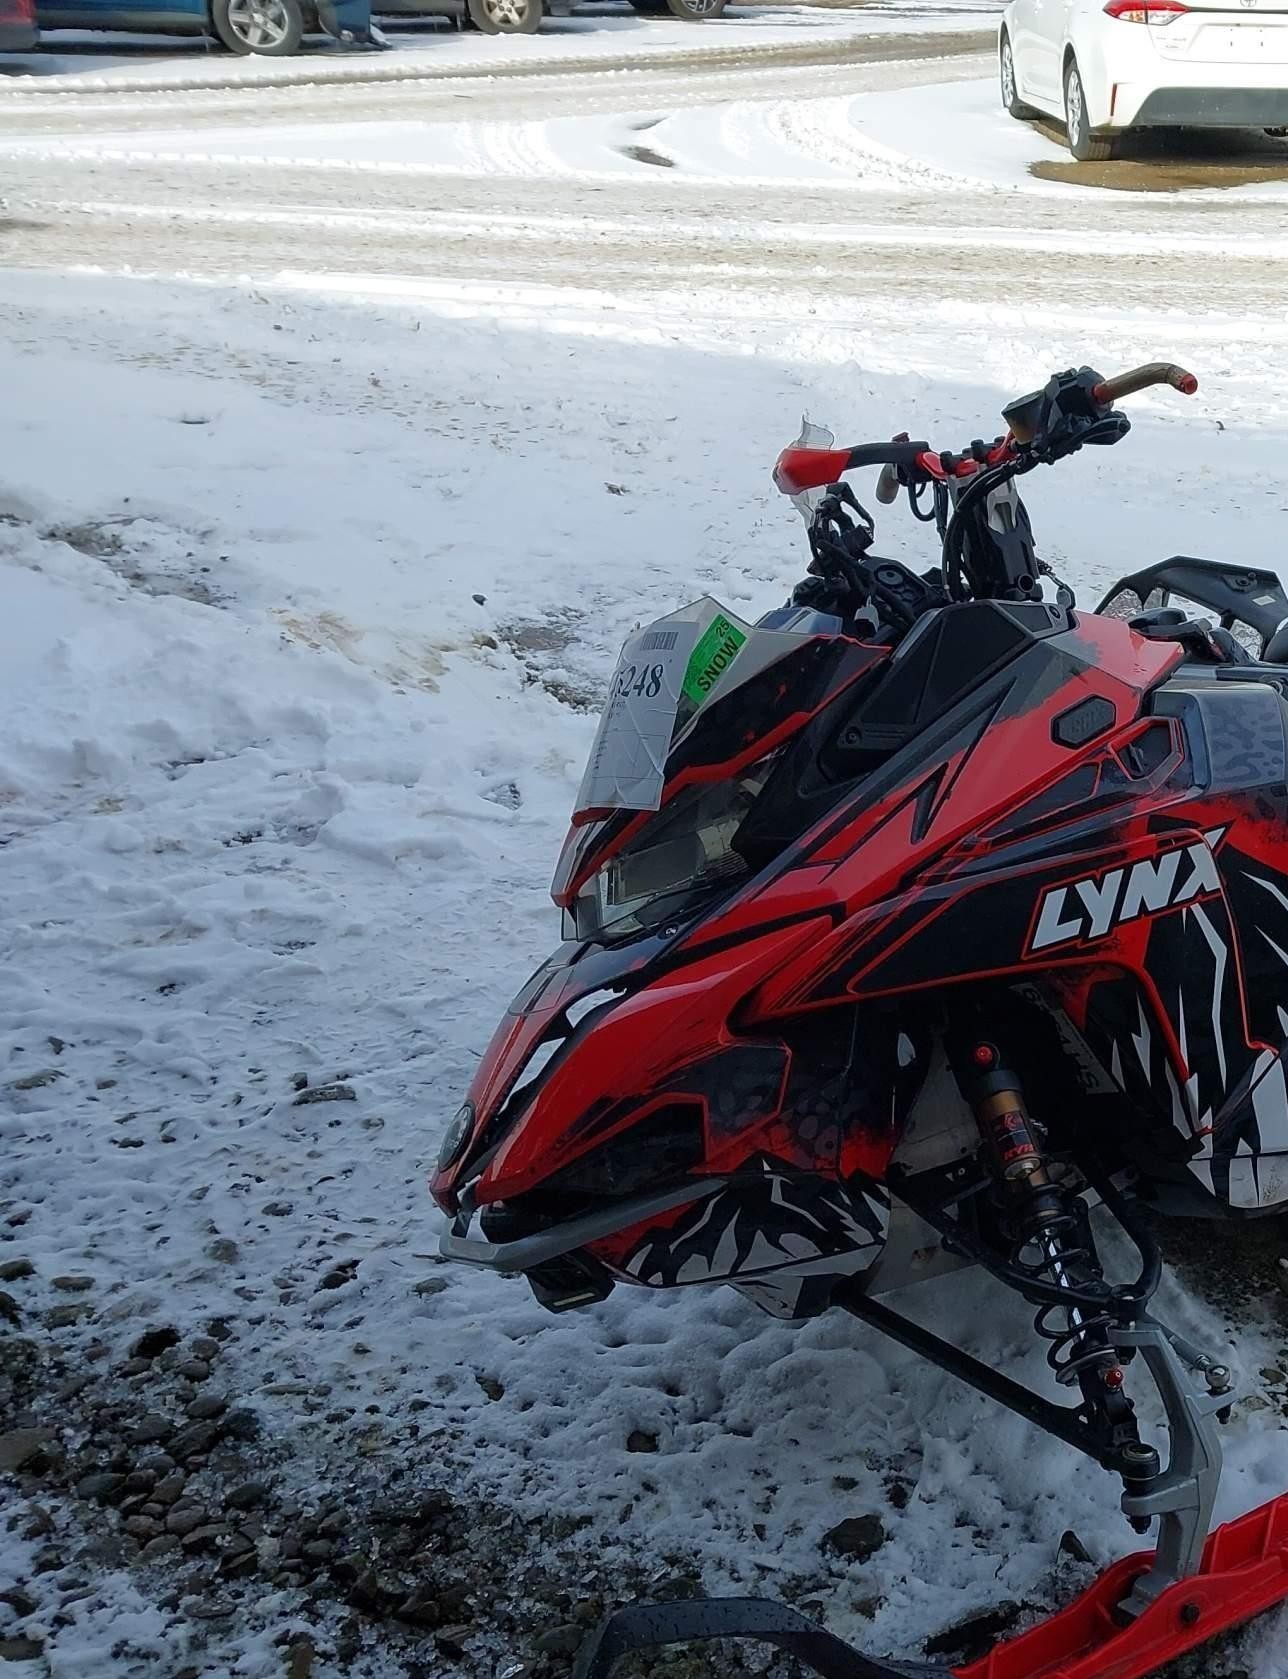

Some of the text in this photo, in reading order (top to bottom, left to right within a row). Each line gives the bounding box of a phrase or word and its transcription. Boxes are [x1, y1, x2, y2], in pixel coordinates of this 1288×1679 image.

[716, 620, 730, 638] 25
[697, 635, 739, 692] SNOW
[1032, 827, 1226, 950] LYNX
